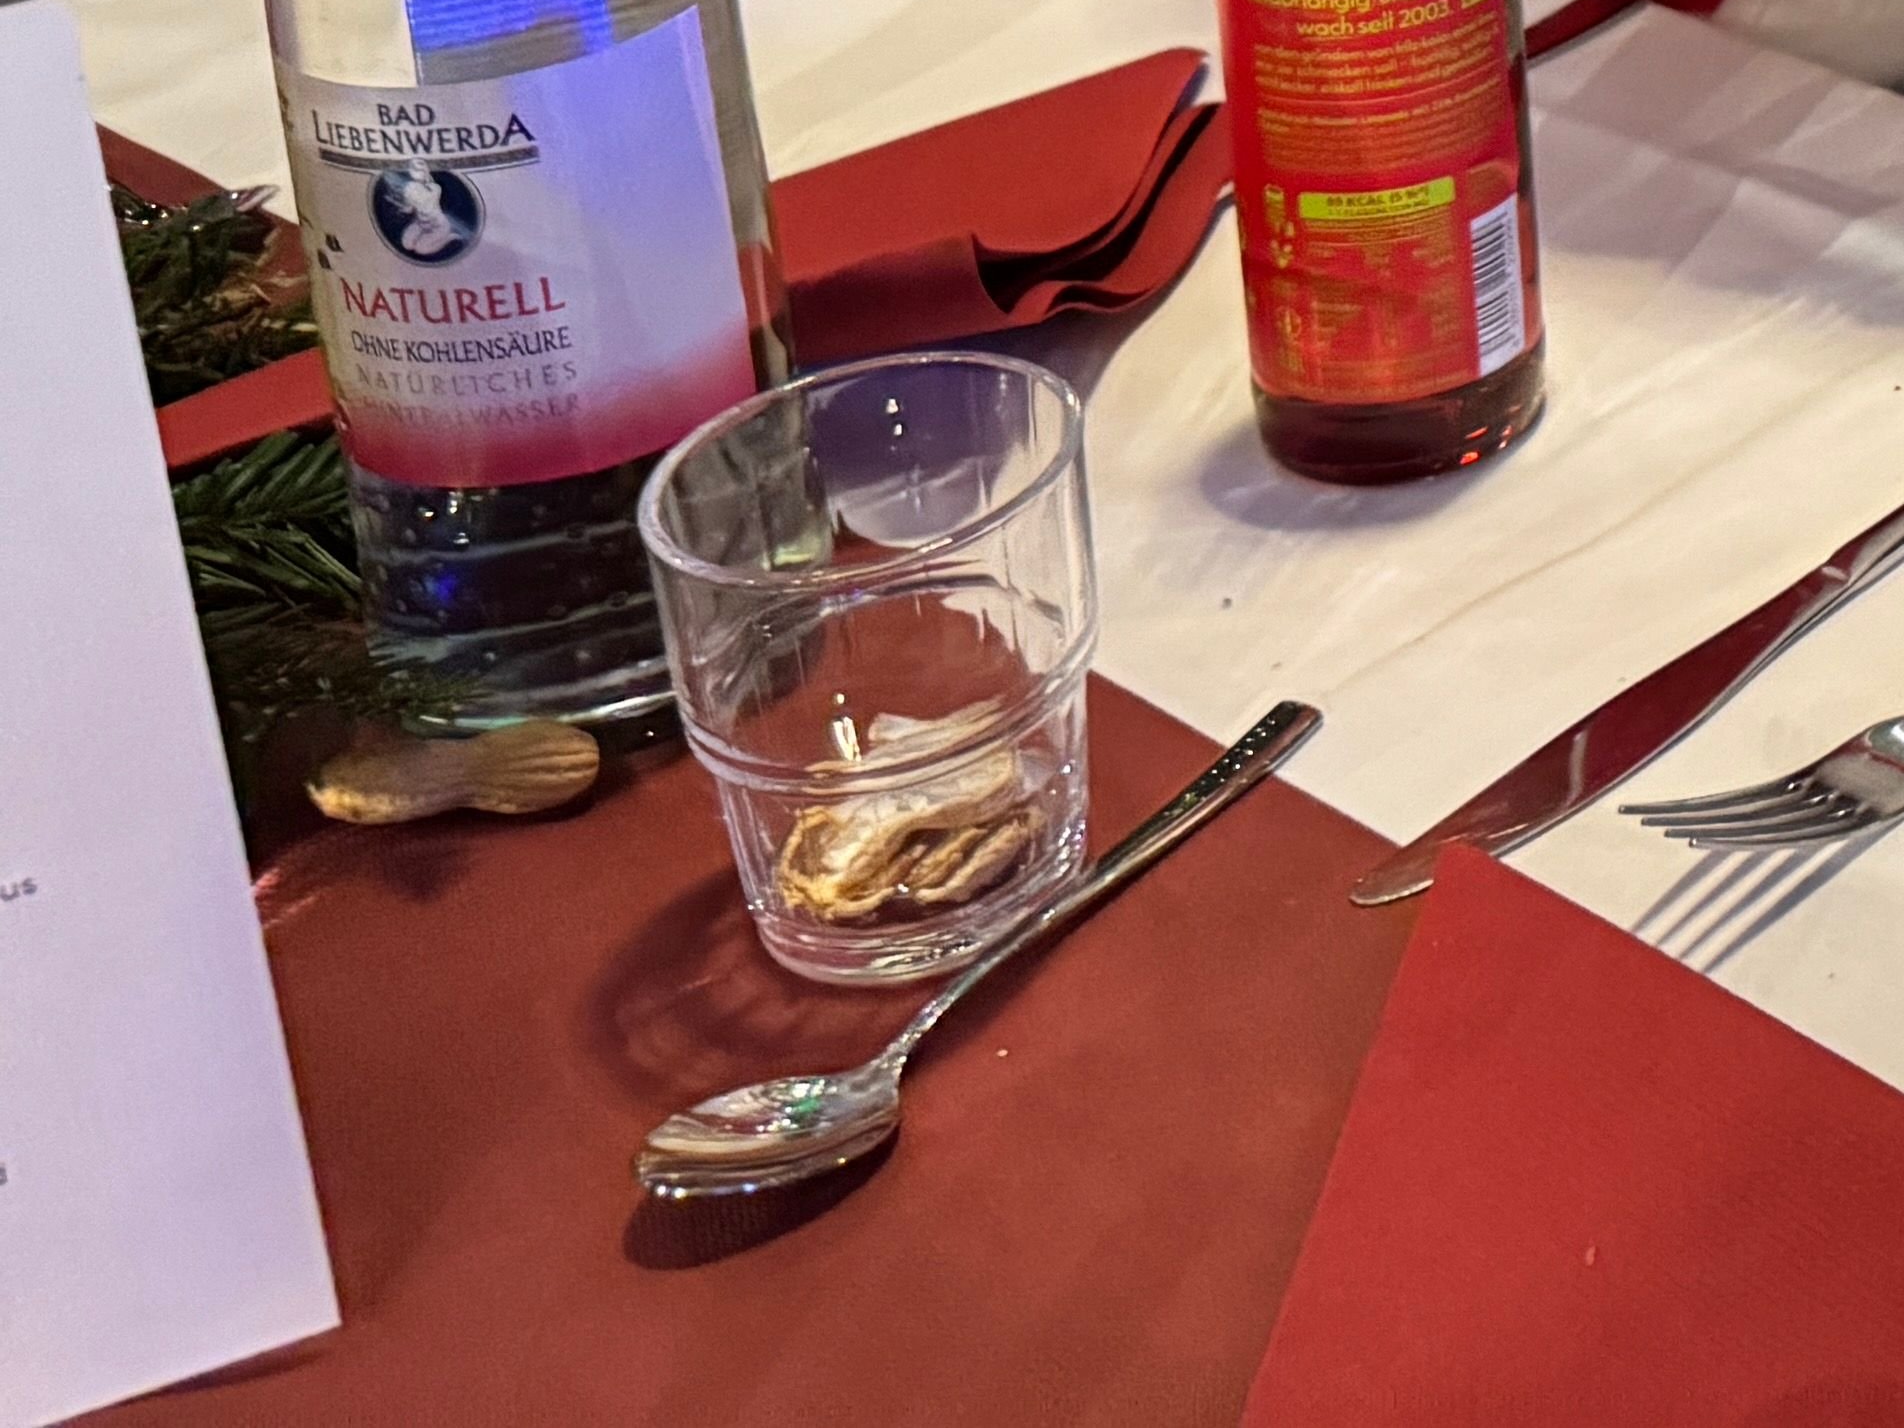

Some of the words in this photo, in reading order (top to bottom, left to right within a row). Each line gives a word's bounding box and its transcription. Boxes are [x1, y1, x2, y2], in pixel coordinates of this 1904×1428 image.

[1296, 15, 1354, 36] wach
[1357, 10, 1395, 34] seit
[312, 109, 536, 155] LIEBENWERDA
[377, 103, 435, 127] BAD
[339, 276, 566, 325] NATURELL
[351, 330, 403, 362] OHNE
[406, 325, 573, 364] KOHLENSÄURE
